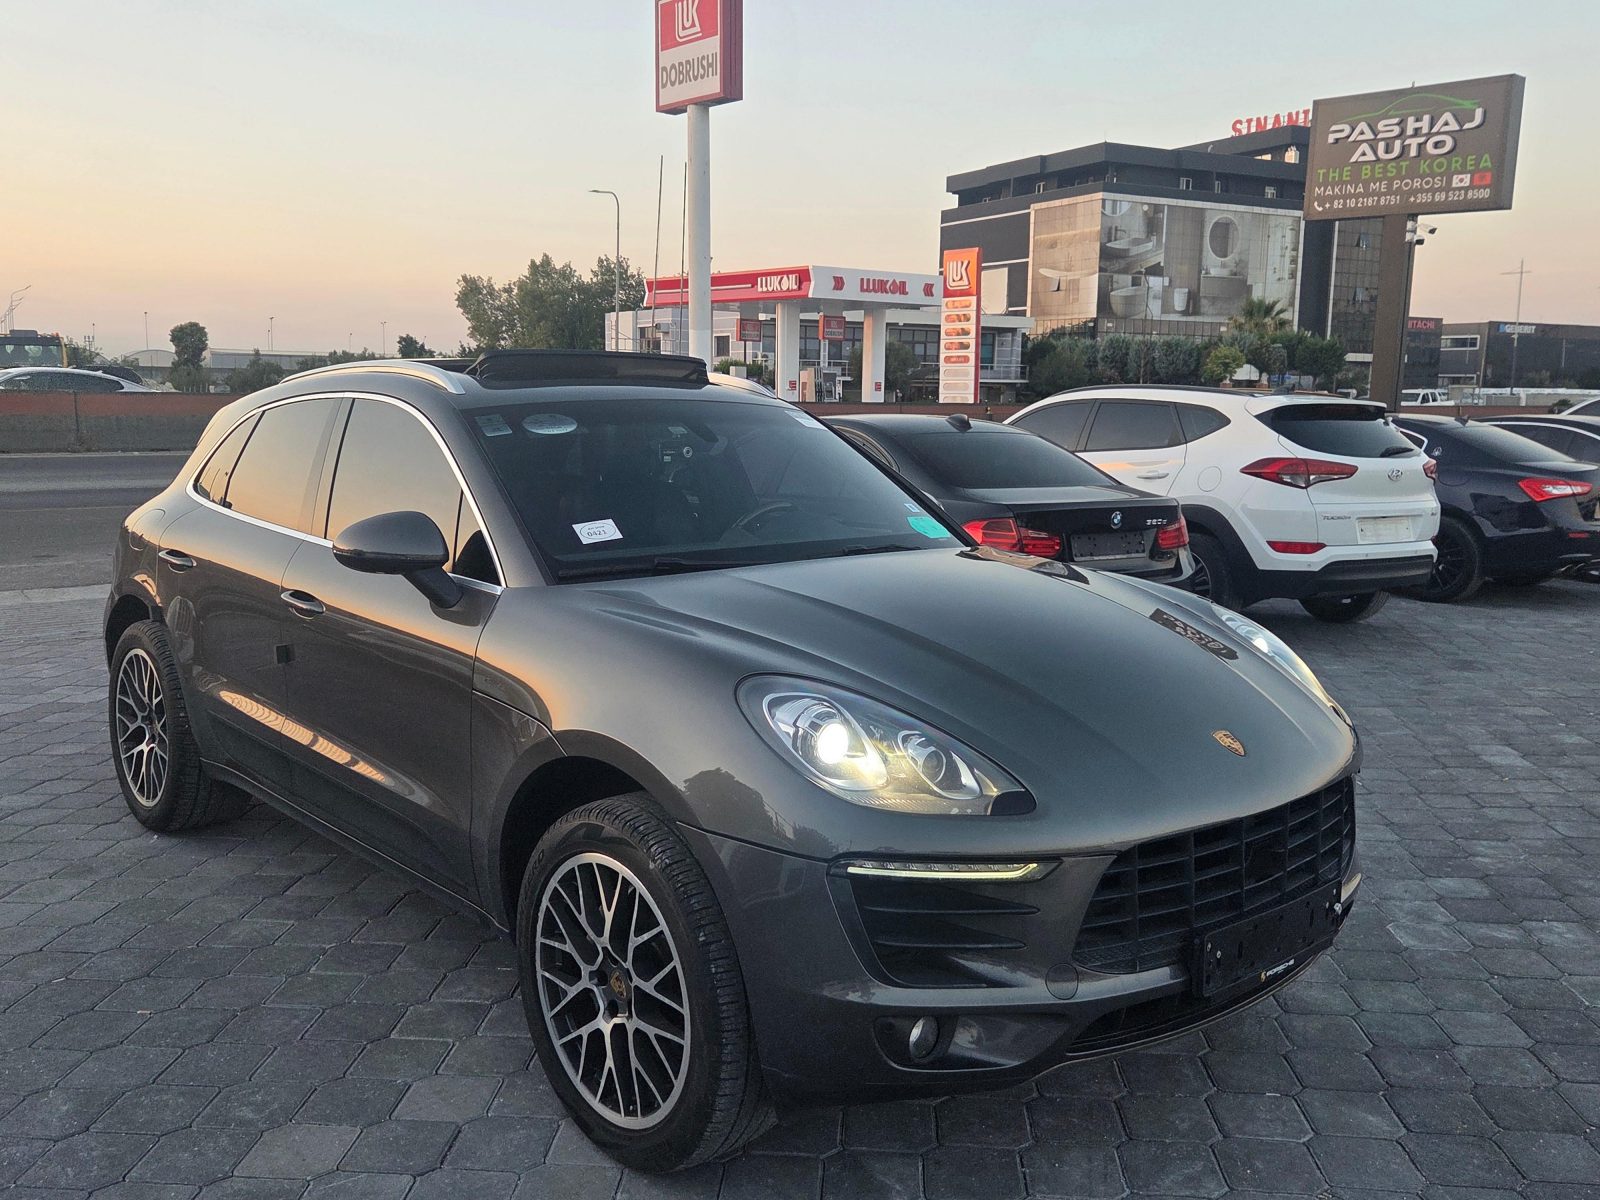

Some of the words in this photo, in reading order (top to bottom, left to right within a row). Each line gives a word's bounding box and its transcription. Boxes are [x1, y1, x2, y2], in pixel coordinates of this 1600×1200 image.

[661, 52, 718, 89] DOBRUSHI
[1231, 108, 1311, 137] SINANI
[1327, 107, 1486, 144] PASHAJ
[1350, 134, 1456, 163] AUTO
[1317, 166, 1352, 182] THE
[1361, 161, 1409, 179] BEST
[1420, 153, 1492, 174] KOREA
[1314, 183, 1364, 197] MAKINA
[1369, 181, 1388, 192] ME
[1393, 176, 1447, 191] POROSI
[1333, 199, 1344, 209] 82
[1346, 198, 1356, 208] 10
[1380, 195, 1400, 205] 8751
[1434, 191, 1446, 202] 69
[1448, 190, 1465, 201] 523
[1467, 188, 1490, 200] 8500
[1505, 324, 1537, 334] GEERIT
